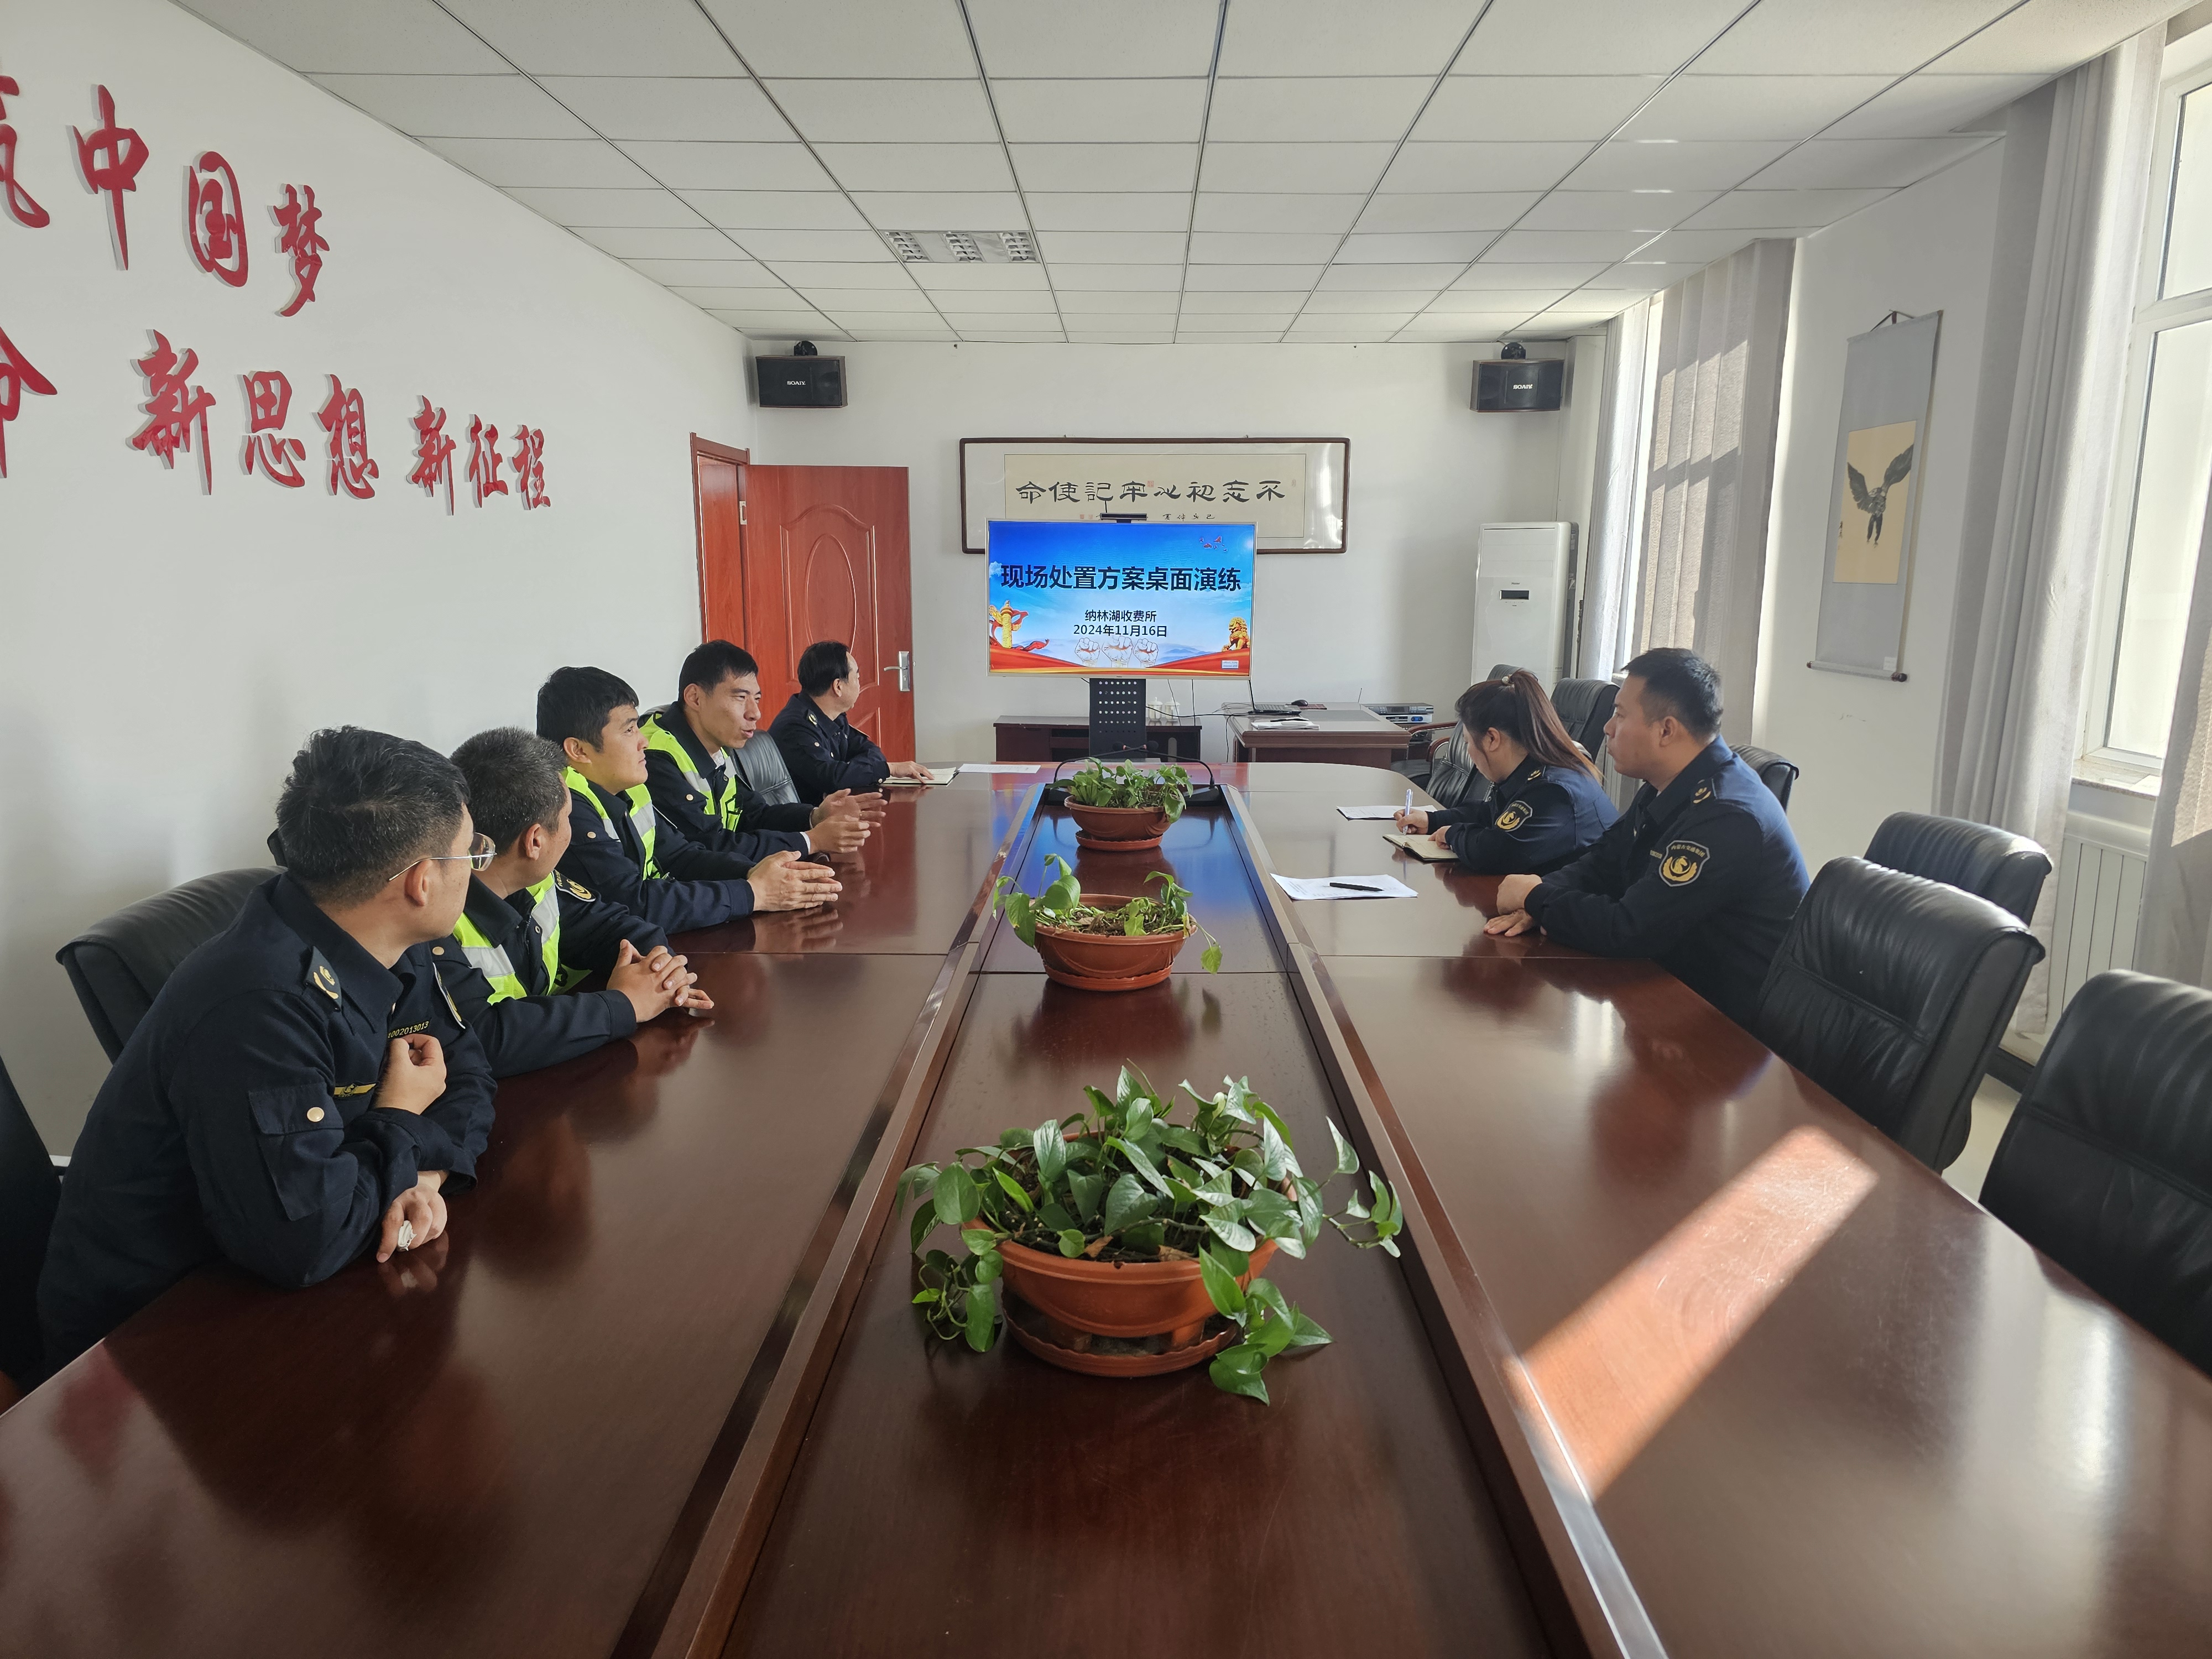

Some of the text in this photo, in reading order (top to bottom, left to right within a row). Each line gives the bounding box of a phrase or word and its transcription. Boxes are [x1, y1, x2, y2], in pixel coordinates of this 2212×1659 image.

[131, 329, 379, 499] 新思想
[409, 395, 551, 515] 新征程
[1000, 564, 1242, 592] 现场处置方案桌面演练
[1084, 609, 1157, 623] 纳林湖收费所
[1073, 624, 1167, 638] 2024年11月16日
